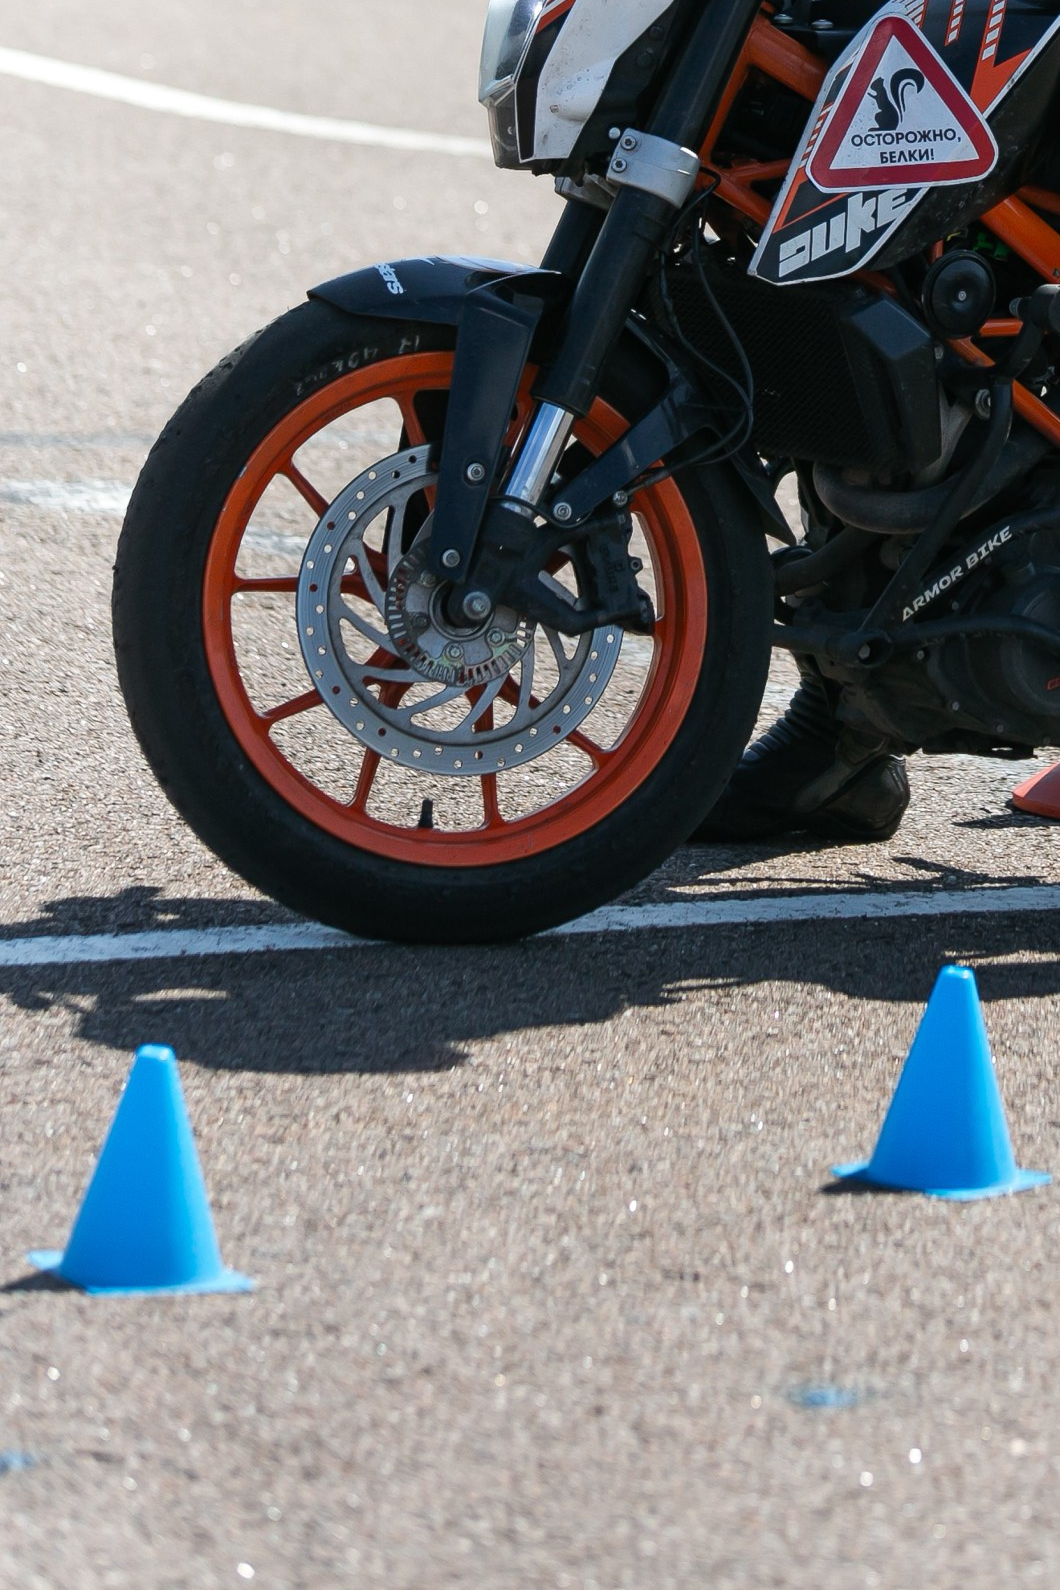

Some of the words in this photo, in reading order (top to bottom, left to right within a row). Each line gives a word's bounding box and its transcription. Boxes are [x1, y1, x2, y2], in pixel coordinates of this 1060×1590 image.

[851, 128, 961, 147] ОСТОРОЖНО,
[880, 148, 935, 164] БЕЛКИ!
[779, 188, 912, 278] DUKE
[902, 565, 964, 622] ARMOR
[965, 525, 1013, 569] BIKE
